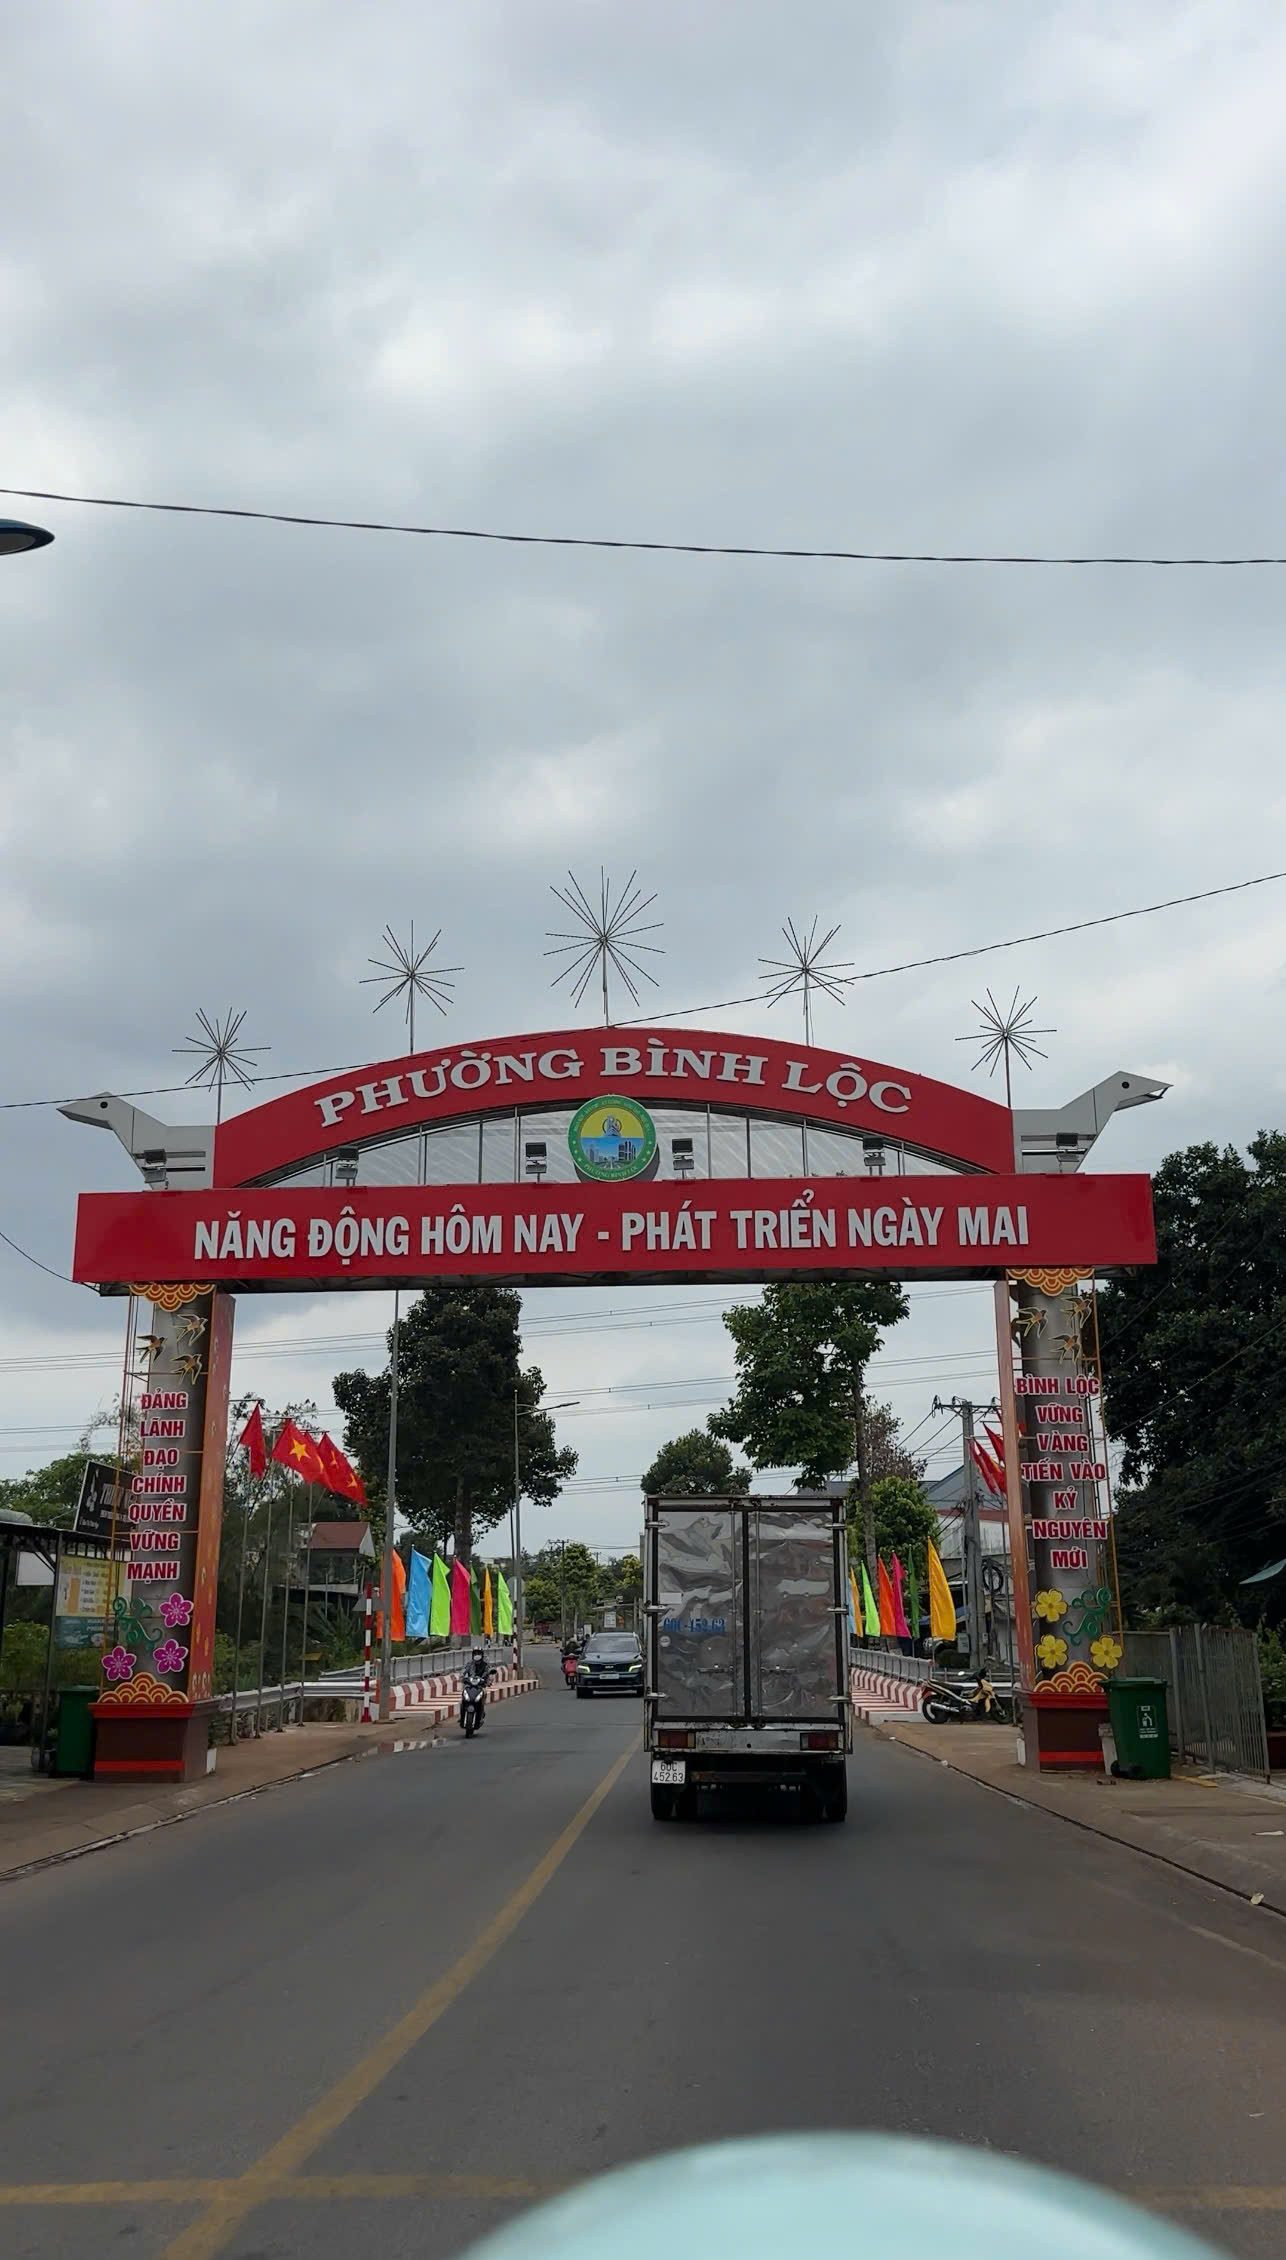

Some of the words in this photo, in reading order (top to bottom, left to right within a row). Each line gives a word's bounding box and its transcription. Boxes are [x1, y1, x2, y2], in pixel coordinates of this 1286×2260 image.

[314, 1049, 584, 1127] PHƯỜNG
[600, 1038, 768, 1085] BÌNH
[782, 1062, 912, 1113] LỘC
[194, 1211, 296, 1259] NĂNG
[308, 1206, 409, 1265] ĐỘNG
[421, 1204, 502, 1254] HÔM
[514, 1214, 583, 1252] NAY
[622, 1201, 717, 1251] PHÁT
[730, 1189, 836, 1249] TRIỂN
[848, 1197, 943, 1246] NGÀY
[958, 1206, 1028, 1246] MAI
[140, 1387, 188, 1410] ĐẢNG
[1015, 1374, 1059, 1396] BÌNH
[1065, 1374, 1100, 1400] LỘC
[1036, 1403, 1084, 1424] VỮNG
[140, 1418, 185, 1438] LÃNH
[1037, 1430, 1088, 1452] VÀNG
[143, 1449, 180, 1470] ĐẠO
[1021, 1457, 1063, 1481] TIẾN
[1069, 1460, 1106, 1480] VÀO
[131, 1469, 187, 1494] CHÍNH
[1053, 1486, 1078, 1510] KỶ
[128, 1498, 186, 1523] QUYỀN
[129, 1528, 180, 1551] VỮNG
[1032, 1518, 1108, 1540] NGUYÊN
[1051, 1547, 1088, 1569] MỚI
[127, 1561, 180, 1584] MẠNH
